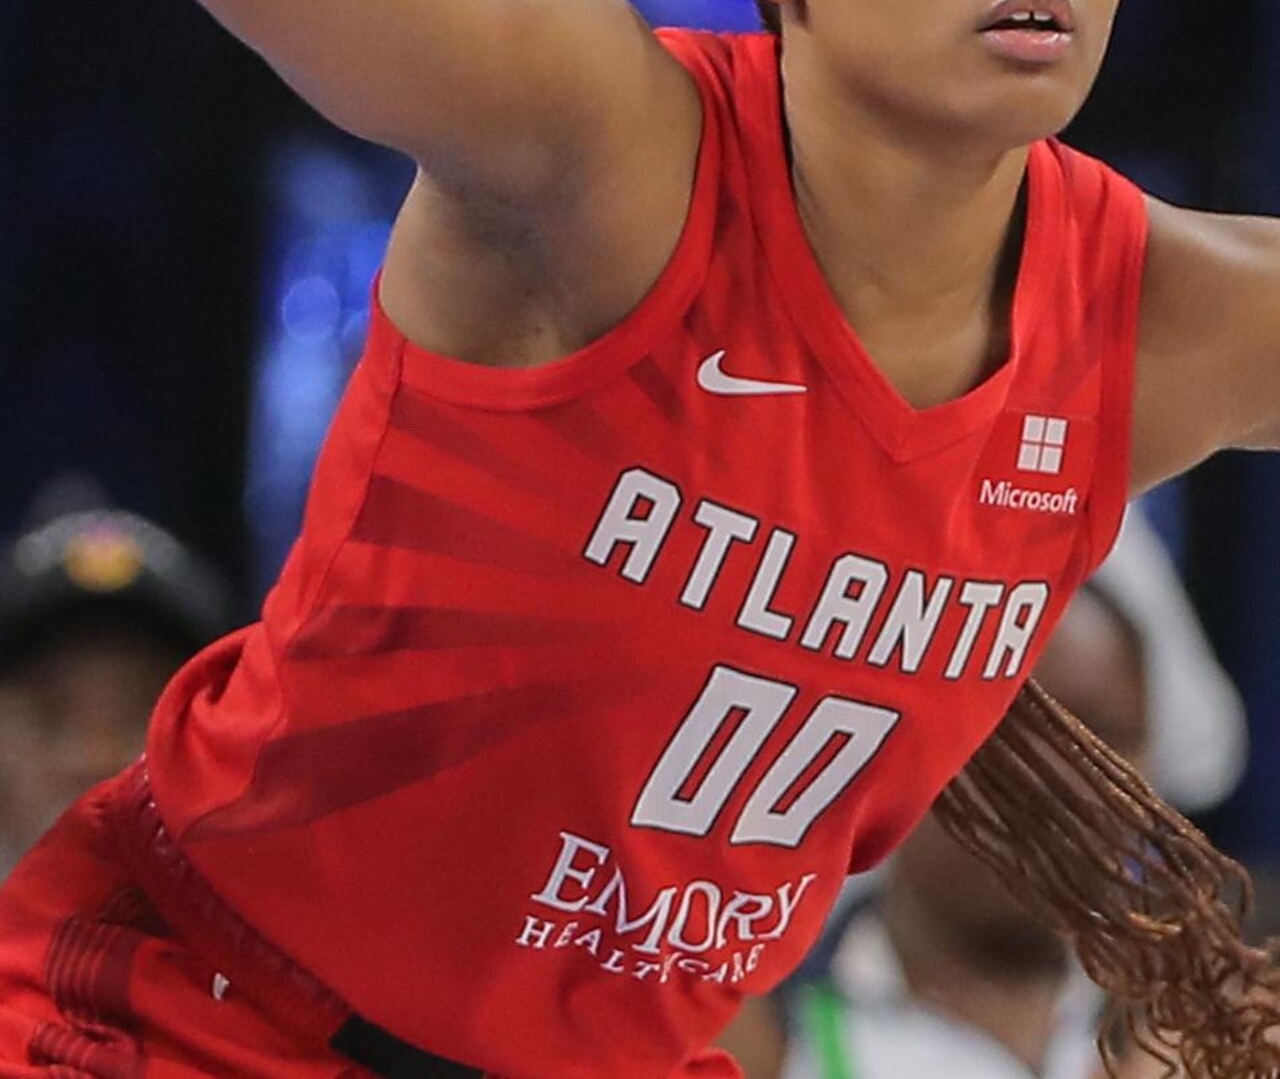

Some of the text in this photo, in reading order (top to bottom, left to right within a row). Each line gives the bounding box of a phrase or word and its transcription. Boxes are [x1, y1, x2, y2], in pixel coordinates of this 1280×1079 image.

[583, 466, 1050, 680] ATLANTA
[979, 478, 1078, 515] Microsoft
[631, 664, 901, 849] 00
[530, 831, 818, 954] EMORY
